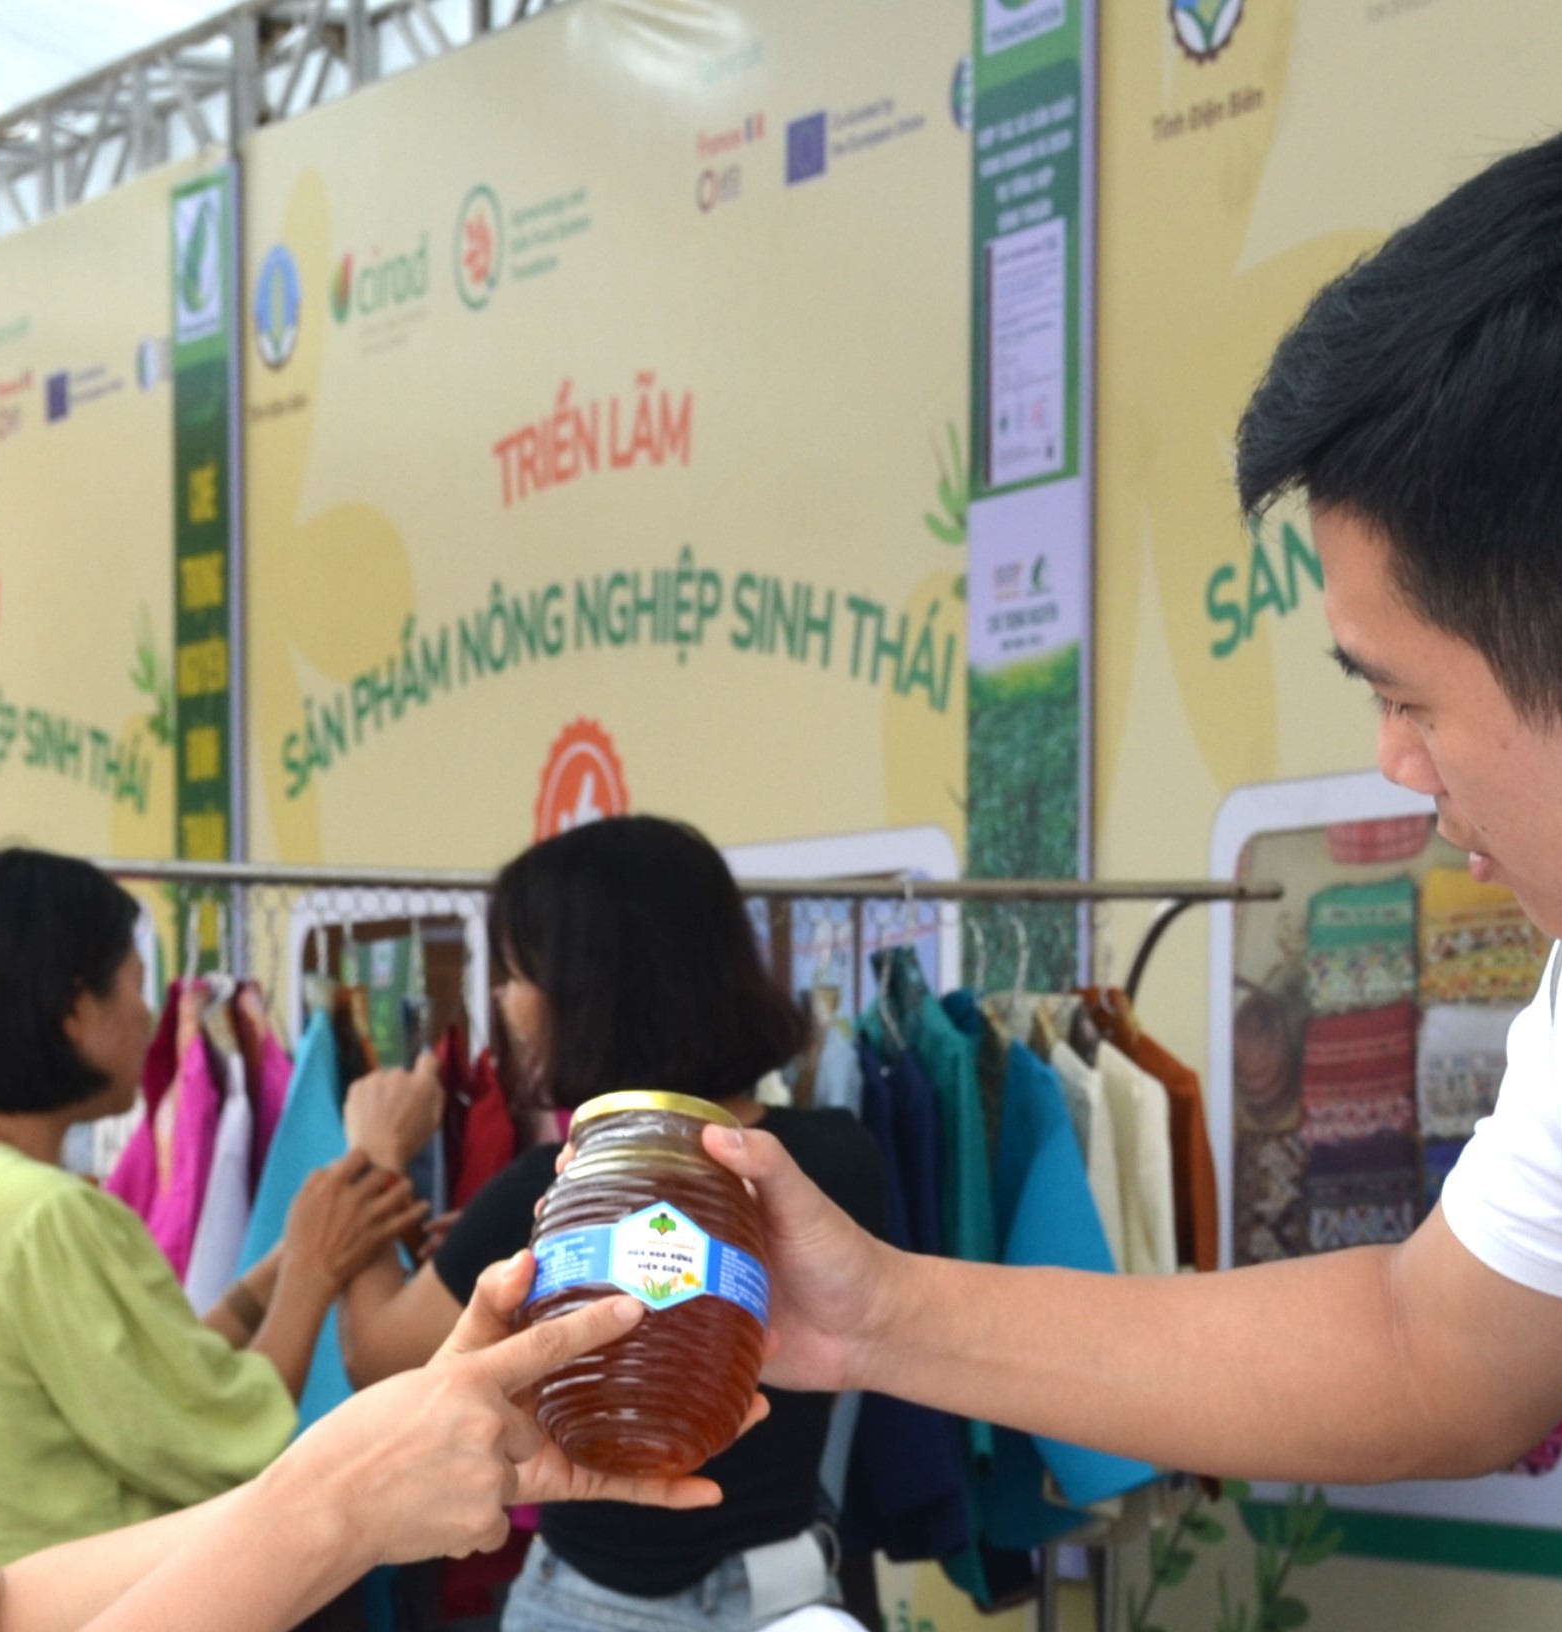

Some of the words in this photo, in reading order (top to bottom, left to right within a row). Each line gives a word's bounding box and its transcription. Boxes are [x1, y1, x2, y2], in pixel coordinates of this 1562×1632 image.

[457, 581, 564, 686] NÔNG
[574, 545, 722, 666] NGHIỆP
[729, 570, 834, 669] SINH
[845, 595, 957, 713] THÁI
